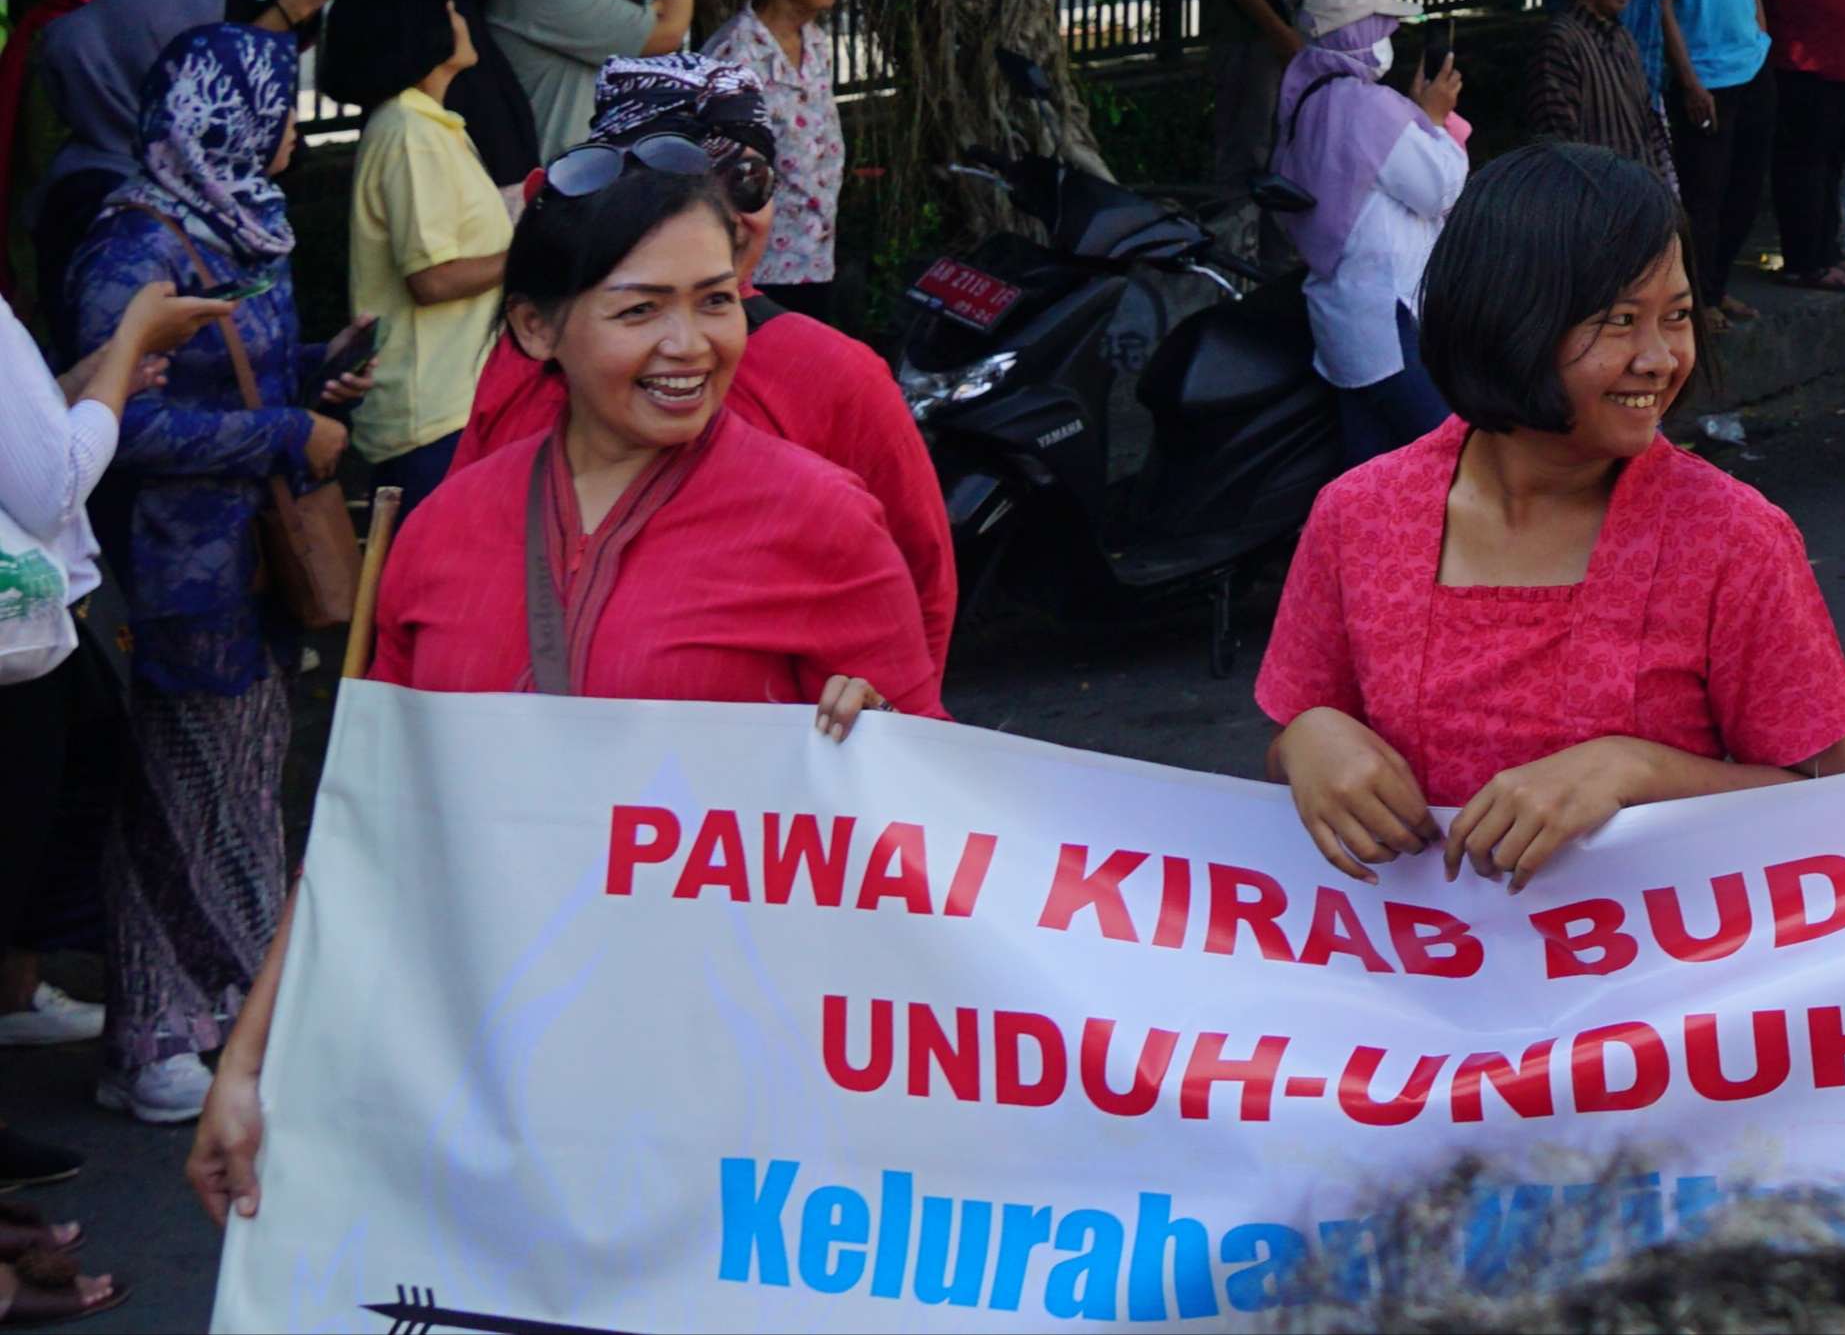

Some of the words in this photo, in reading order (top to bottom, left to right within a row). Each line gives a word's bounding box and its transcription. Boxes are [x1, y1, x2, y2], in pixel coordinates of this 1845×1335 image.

[1037, 418, 1084, 448] YAMAHA
[606, 806, 998, 917] PAWAI
[1039, 844, 1484, 977] KIRAB
